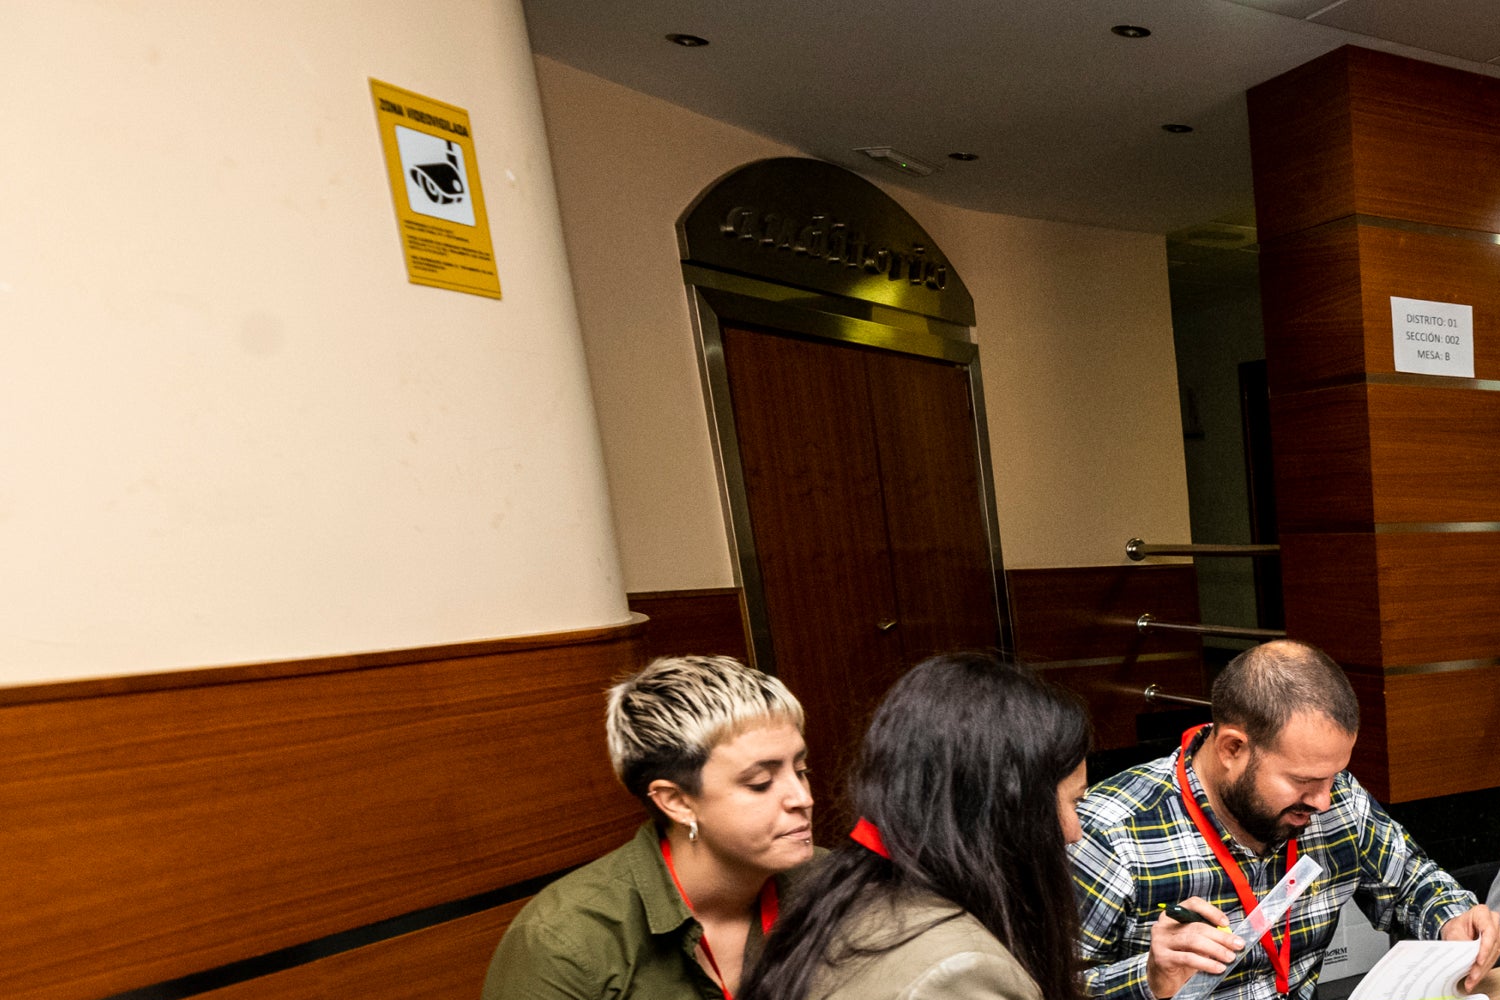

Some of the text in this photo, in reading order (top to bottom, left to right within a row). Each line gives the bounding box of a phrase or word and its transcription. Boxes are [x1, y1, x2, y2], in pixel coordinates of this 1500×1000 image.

[1406, 313, 1458, 328] DISTRITO: 01
[1406, 331, 1460, 345] SECCIÓN: 002
[1417, 350, 1451, 361] MESA: B
